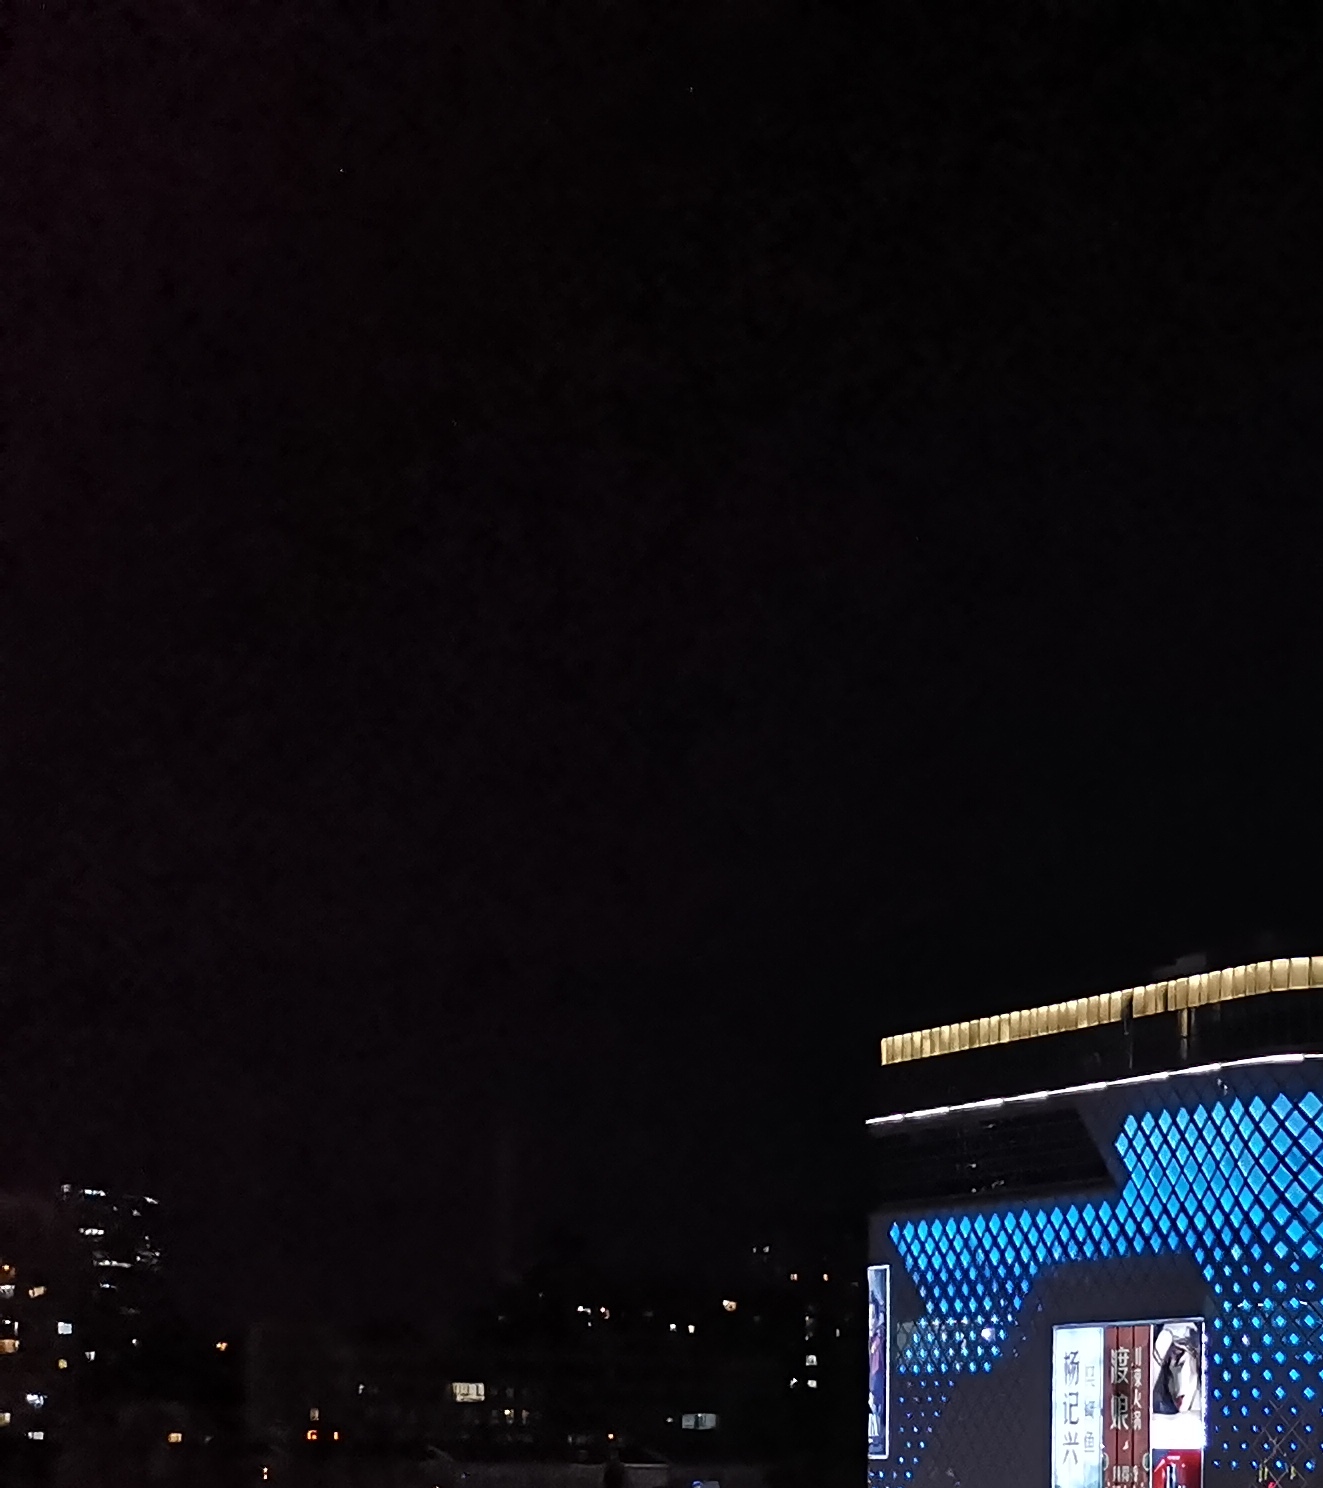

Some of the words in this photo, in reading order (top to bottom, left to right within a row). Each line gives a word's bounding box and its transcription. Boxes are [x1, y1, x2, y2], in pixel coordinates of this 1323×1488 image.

[1063, 1350, 1080, 1465] 杨记兴
[1109, 1346, 1130, 1431] 渡娘
